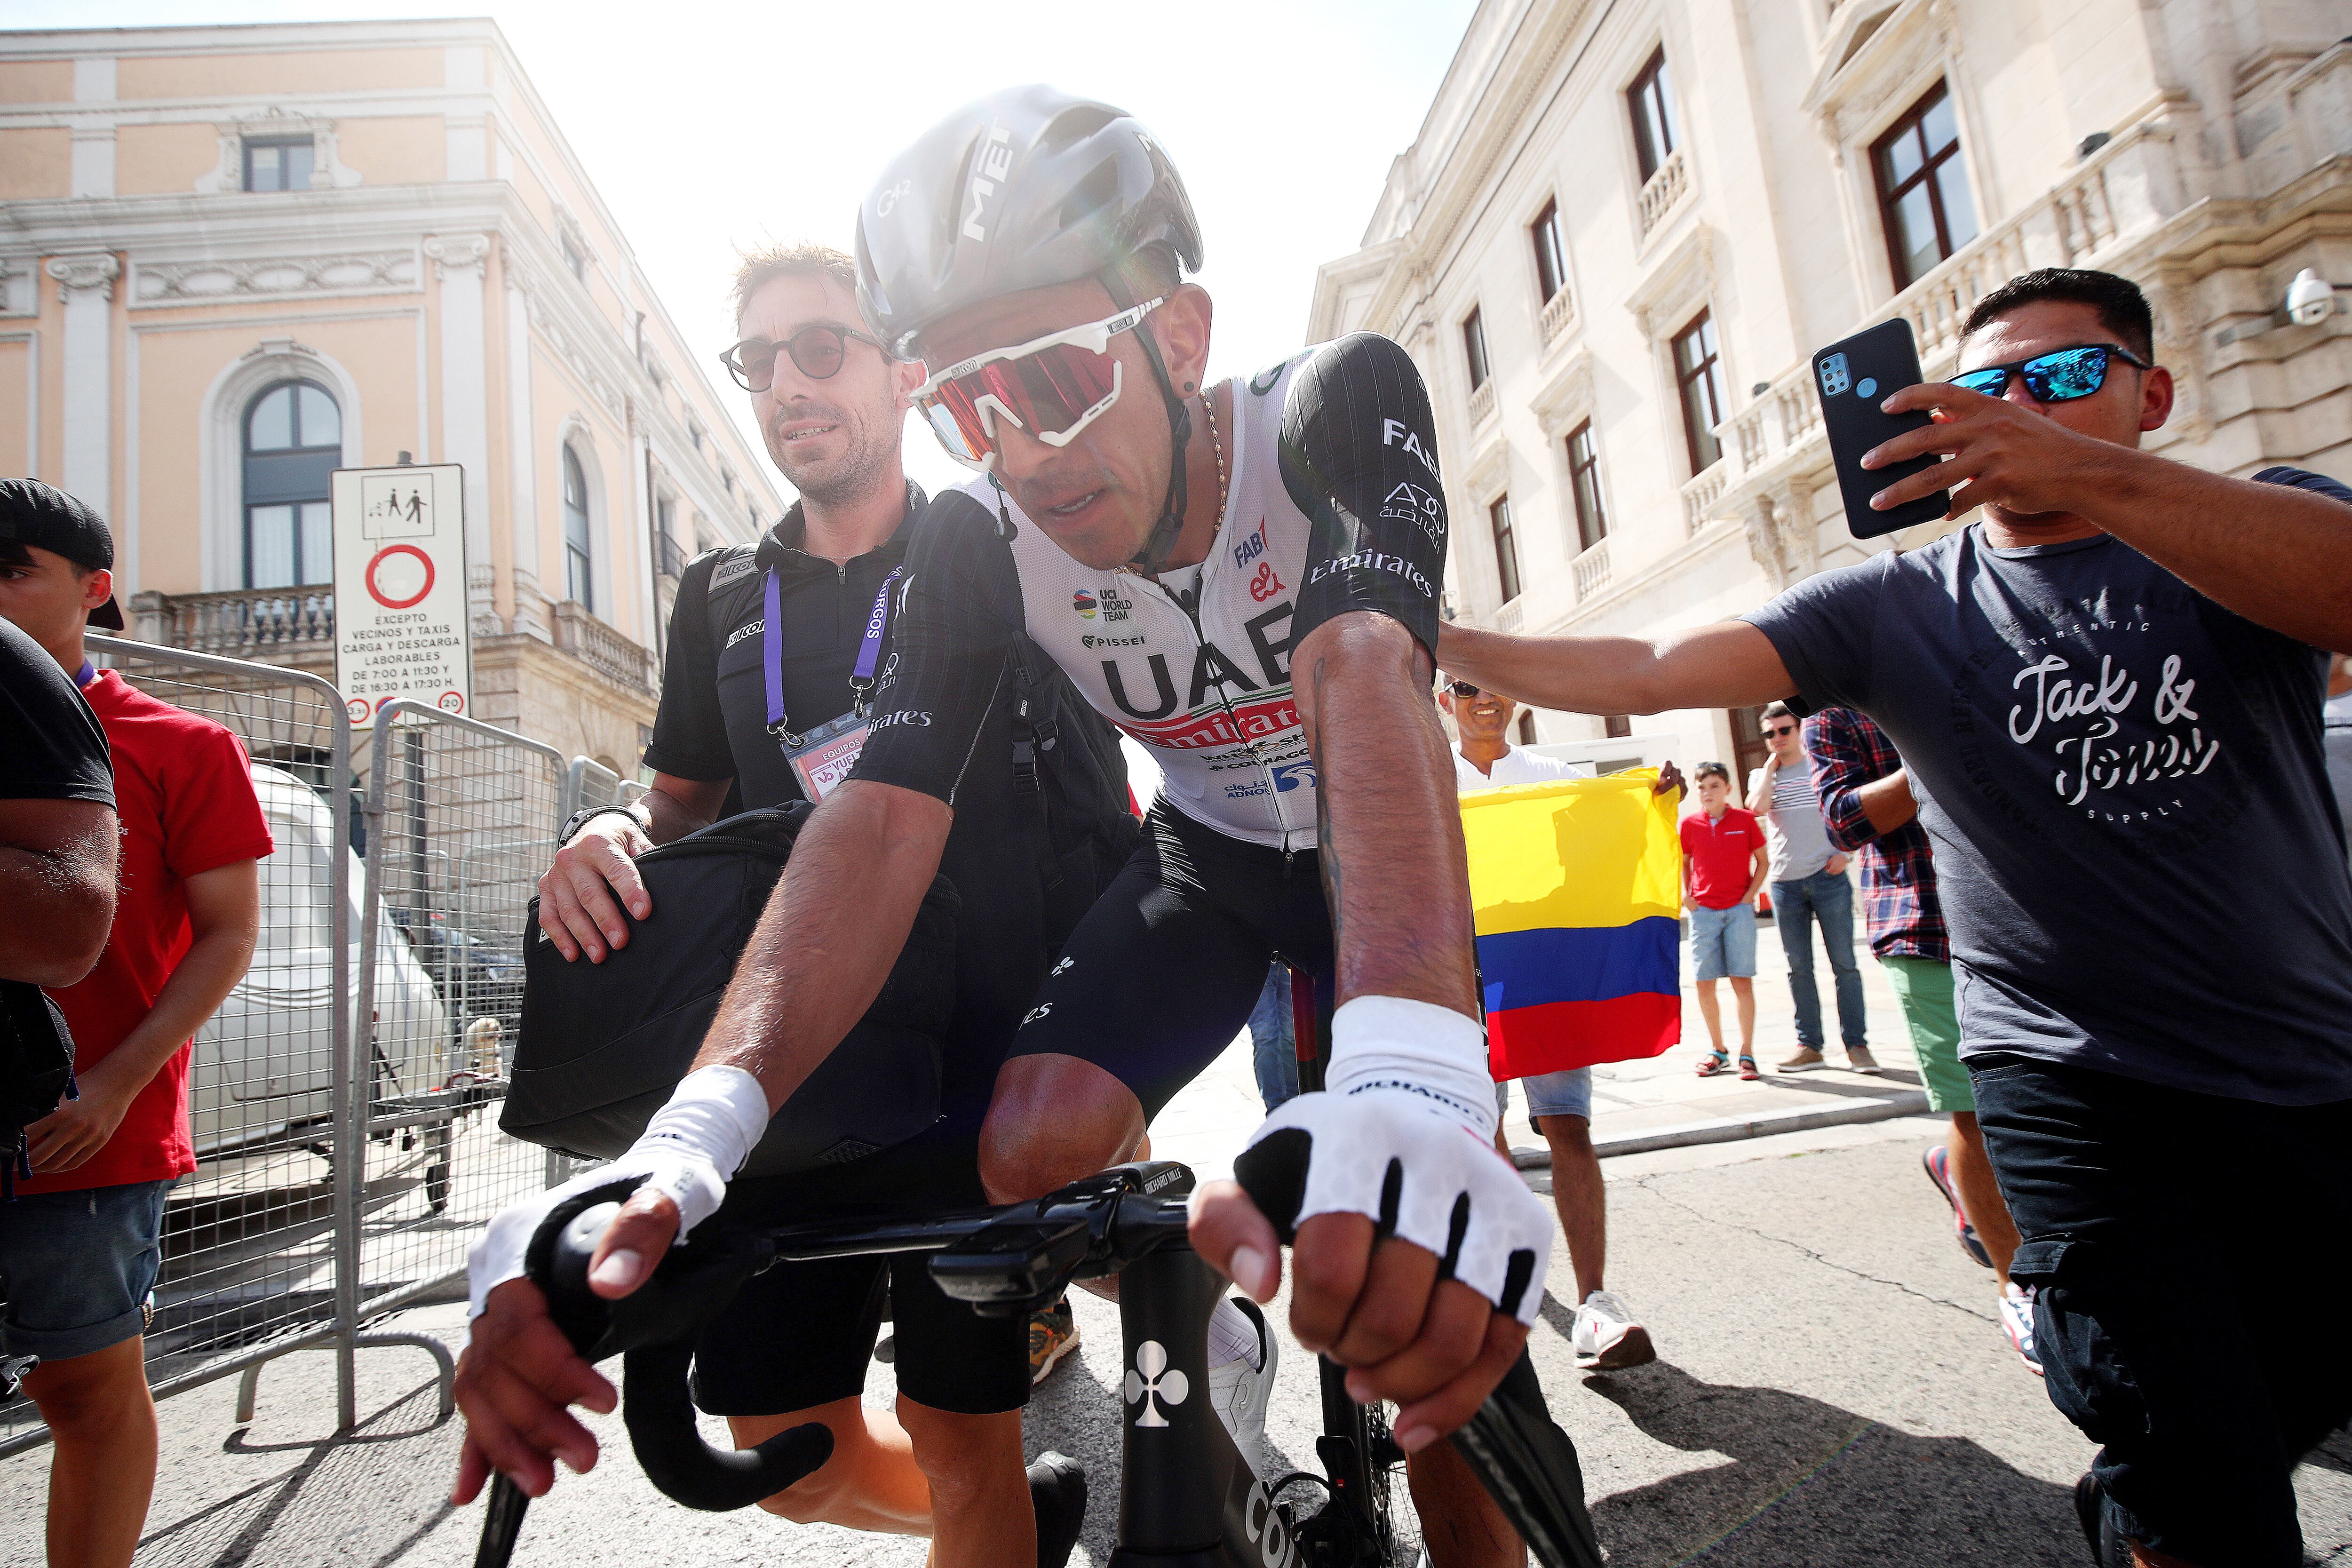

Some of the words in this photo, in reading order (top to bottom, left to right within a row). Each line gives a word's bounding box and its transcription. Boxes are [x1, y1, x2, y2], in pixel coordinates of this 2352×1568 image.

[963, 117, 1014, 242] MET
[1309, 548, 1432, 598] Emirates
[1099, 589, 1117, 600] UCI
[866, 578, 891, 639] BURGOS
[1101, 600, 1132, 611] WORLD
[375, 613, 427, 625] EXCEPTO
[1103, 610, 1129, 622] TEAM
[352, 628, 402, 639] VECINOS
[406, 627, 413, 636] Y
[418, 624, 450, 635] TAXIS
[2017, 621, 2150, 656] AUTHENTIC
[342, 643, 382, 653] CARGA
[397, 637, 460, 649] DESCARGA
[1097, 636, 1145, 647] PISSEI
[365, 651, 441, 665] LABORABLES
[1101, 600, 1295, 720] UAE
[352, 671, 367, 680] DE
[372, 669, 397, 678] 7:00
[401, 668, 408, 677] A
[413, 666, 438, 676] 11:30
[442, 665, 448, 673] Y
[351, 684, 366, 693] DE
[370, 682, 398, 692] 16:30
[414, 679, 441, 688] 17:30
[443, 699, 458, 707] 20
[2009, 654, 2138, 744] Jack
[2154, 654, 2199, 724] &
[866, 709, 932, 742] irates
[821, 738, 861, 761] EQUIPOS
[2086, 799, 2183, 824] SUPPLY
[1144, 1174, 1169, 1195] RICHARD
